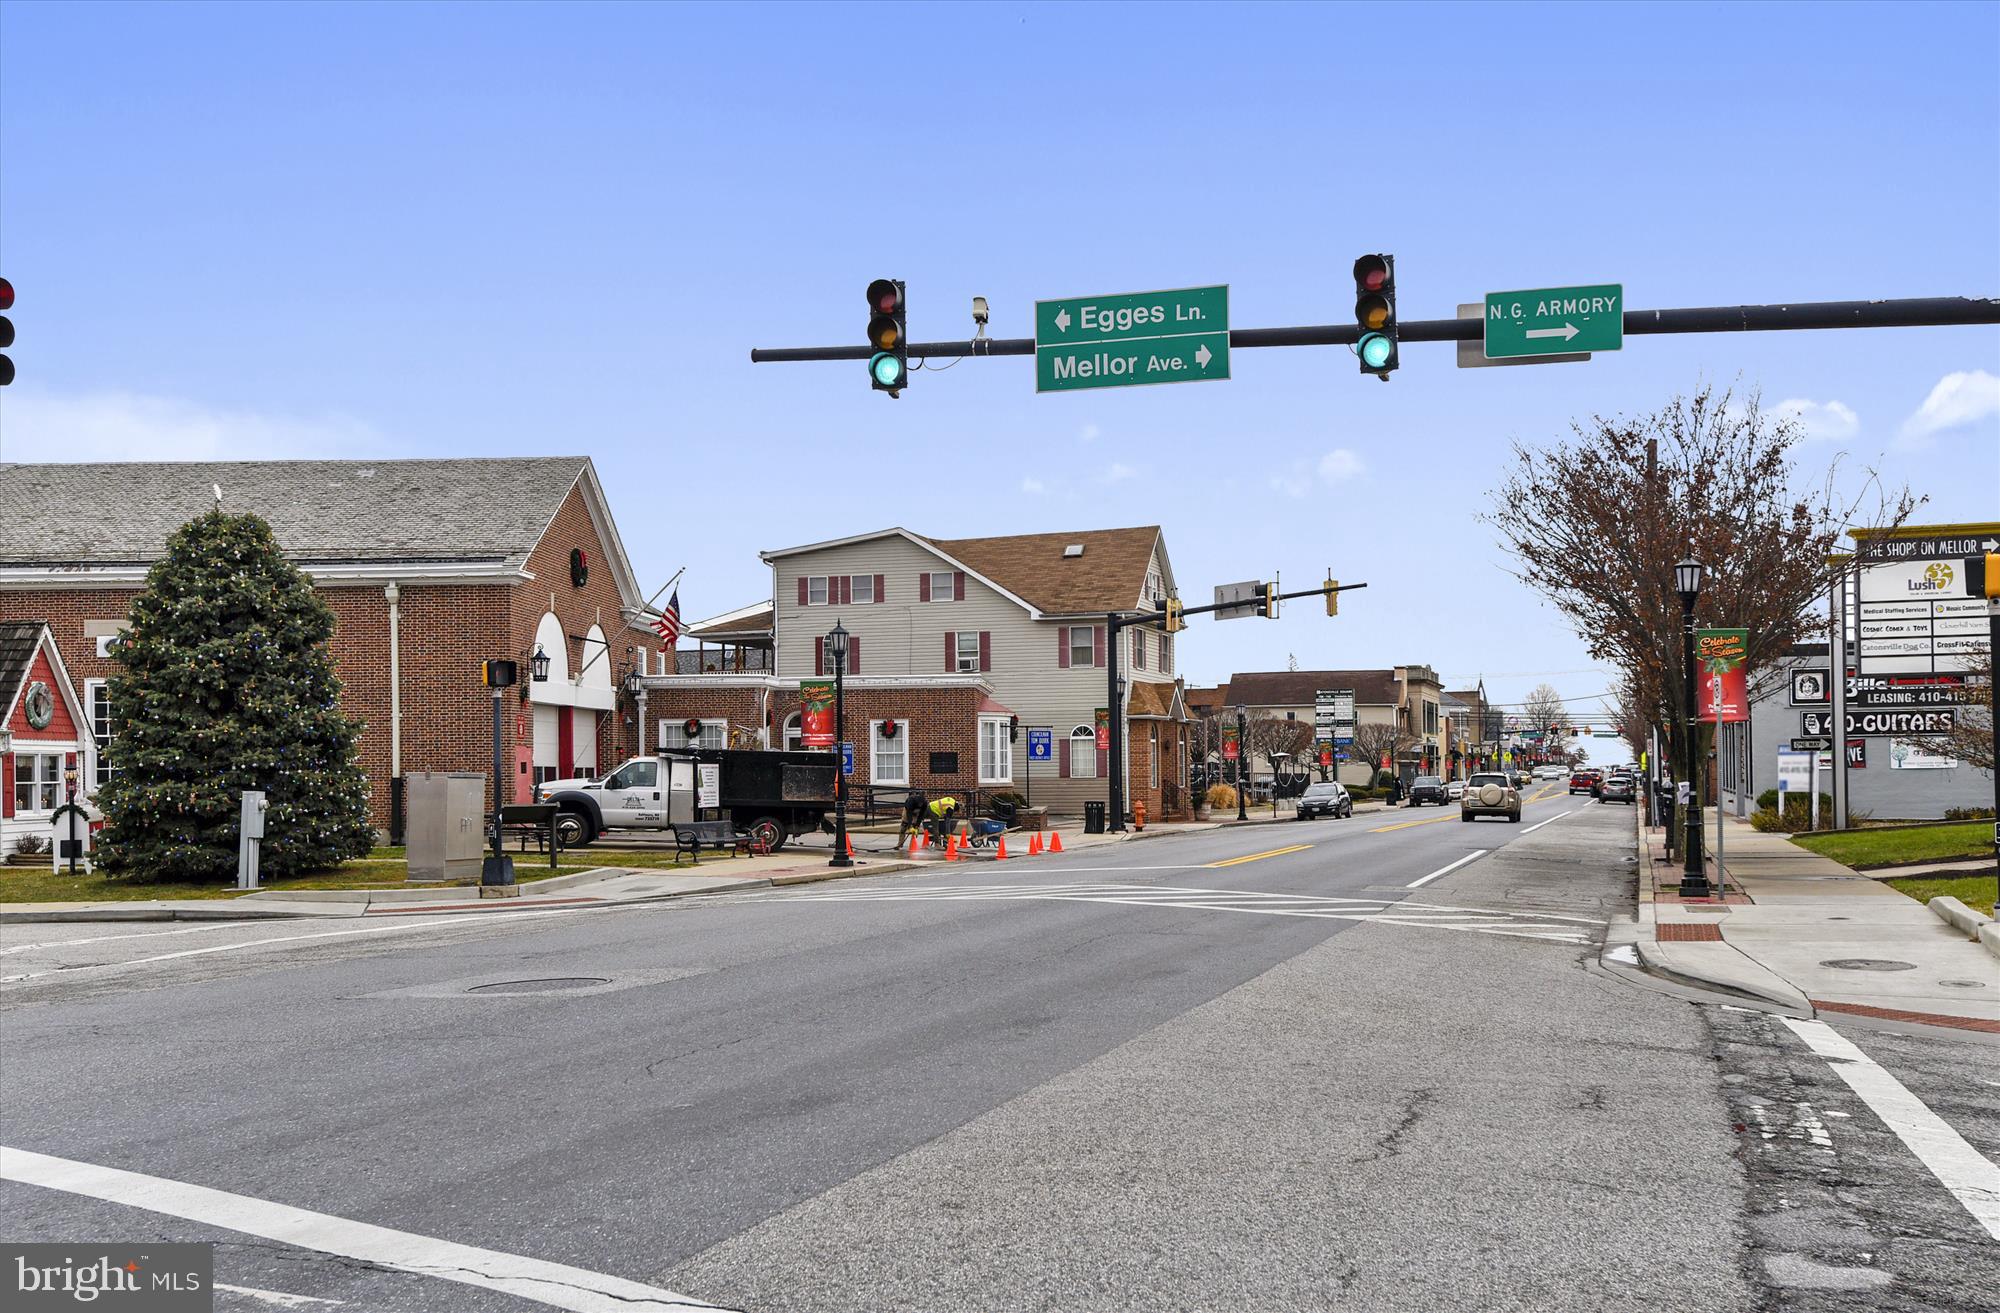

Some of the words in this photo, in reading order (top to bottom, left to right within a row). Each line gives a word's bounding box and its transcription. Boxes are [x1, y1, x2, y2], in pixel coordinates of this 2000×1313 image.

[1536, 296, 1618, 317] ARMORY
[1080, 304, 1165, 333] Egges
[1175, 303, 1207, 323] Ln.
[1053, 353, 1138, 380] Mellor
[1146, 354, 1188, 373] Ave.
[1887, 542, 1917, 557] SHOPS
[1921, 541, 1935, 555] ON
[1939, 539, 1977, 555] MELLOR
[1908, 579, 1936, 591] Lush
[1700, 636, 1739, 648] Celebrate
[1862, 643, 1902, 651] Catonsville
[1903, 643, 1919, 651] Dog
[1919, 642, 1931, 650] Co.
[1711, 646, 1744, 657] Season
[1867, 693, 1915, 704] LEASING:
